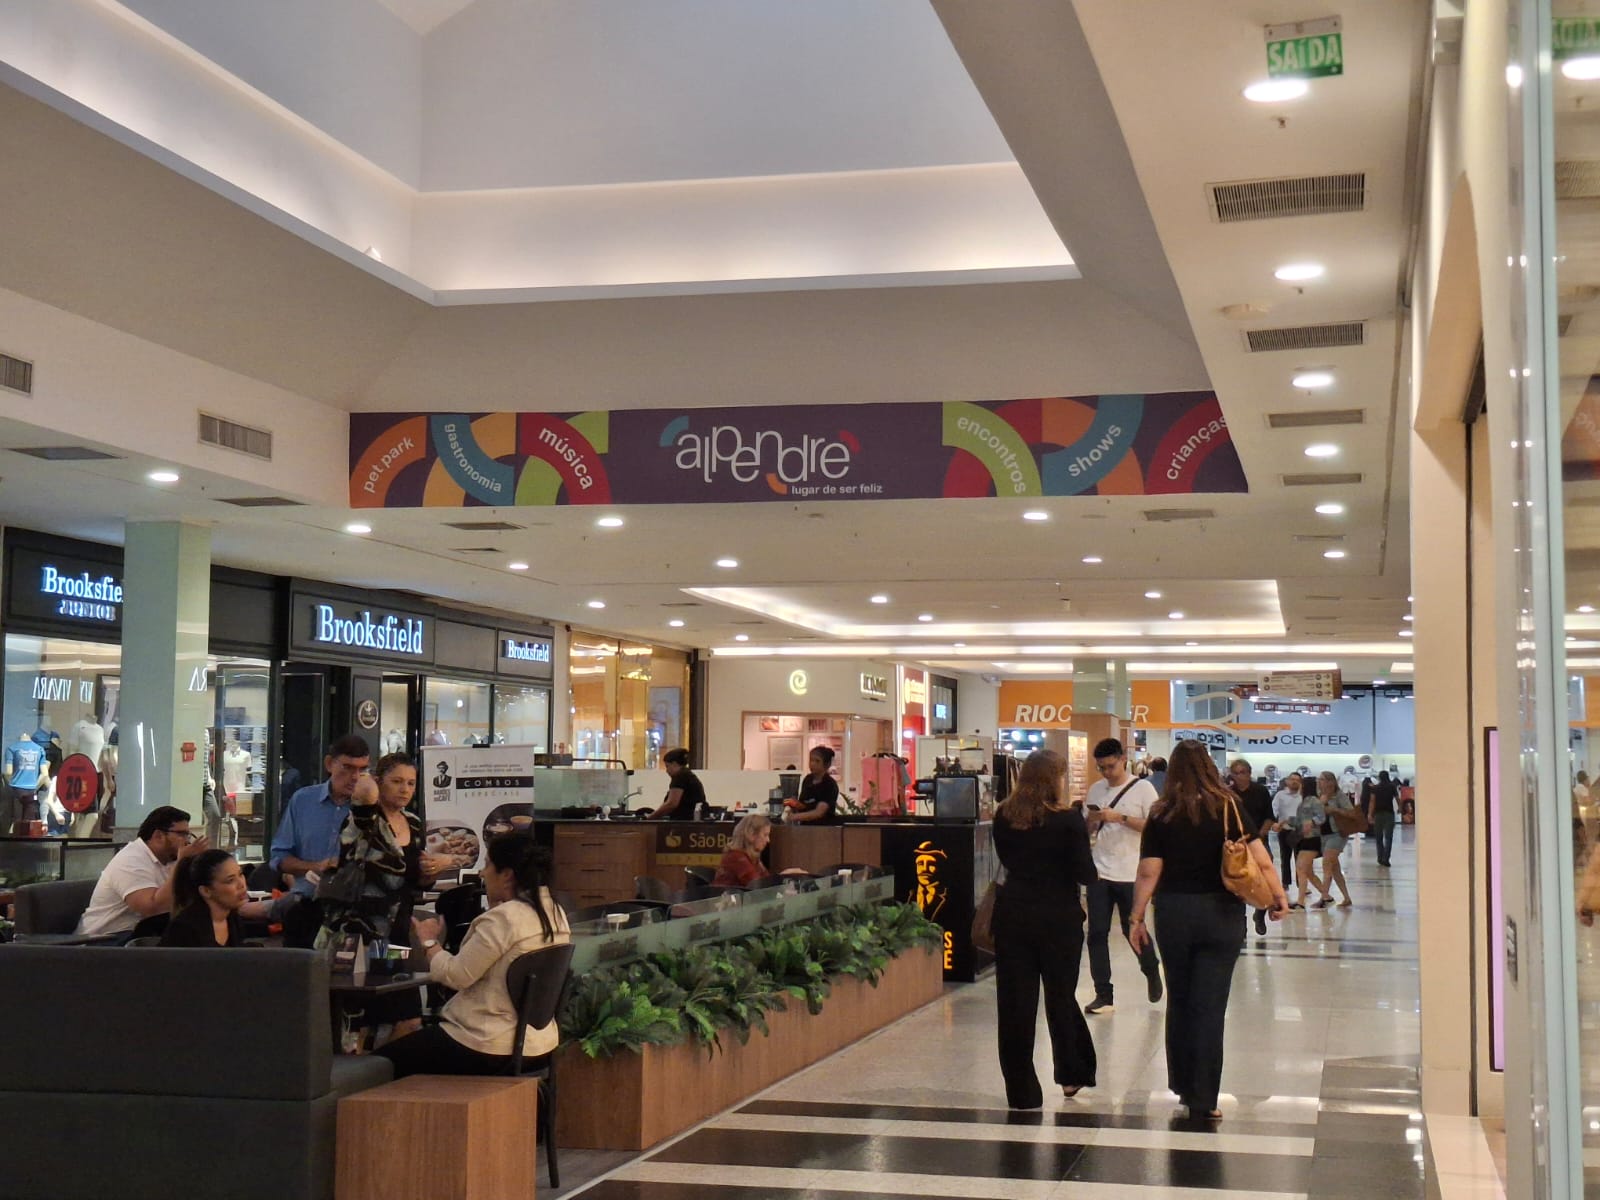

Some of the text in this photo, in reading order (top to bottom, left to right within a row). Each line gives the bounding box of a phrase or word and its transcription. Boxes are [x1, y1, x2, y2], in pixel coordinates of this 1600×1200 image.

[363, 437, 415, 494] pet park
[444, 423, 502, 493] gastronomia
[538, 427, 593, 491] música
[675, 425, 850, 483] alpendre
[957, 416, 1026, 494] encontros
[1068, 424, 1122, 478] shows
[792, 483, 883, 497] lugar de ser feliz
[42, 566, 124, 603] Brooksfie
[318, 604, 423, 654] Brooksfield
[508, 639, 549, 662] Brooksfield
[689, 833, 715, 848] São
